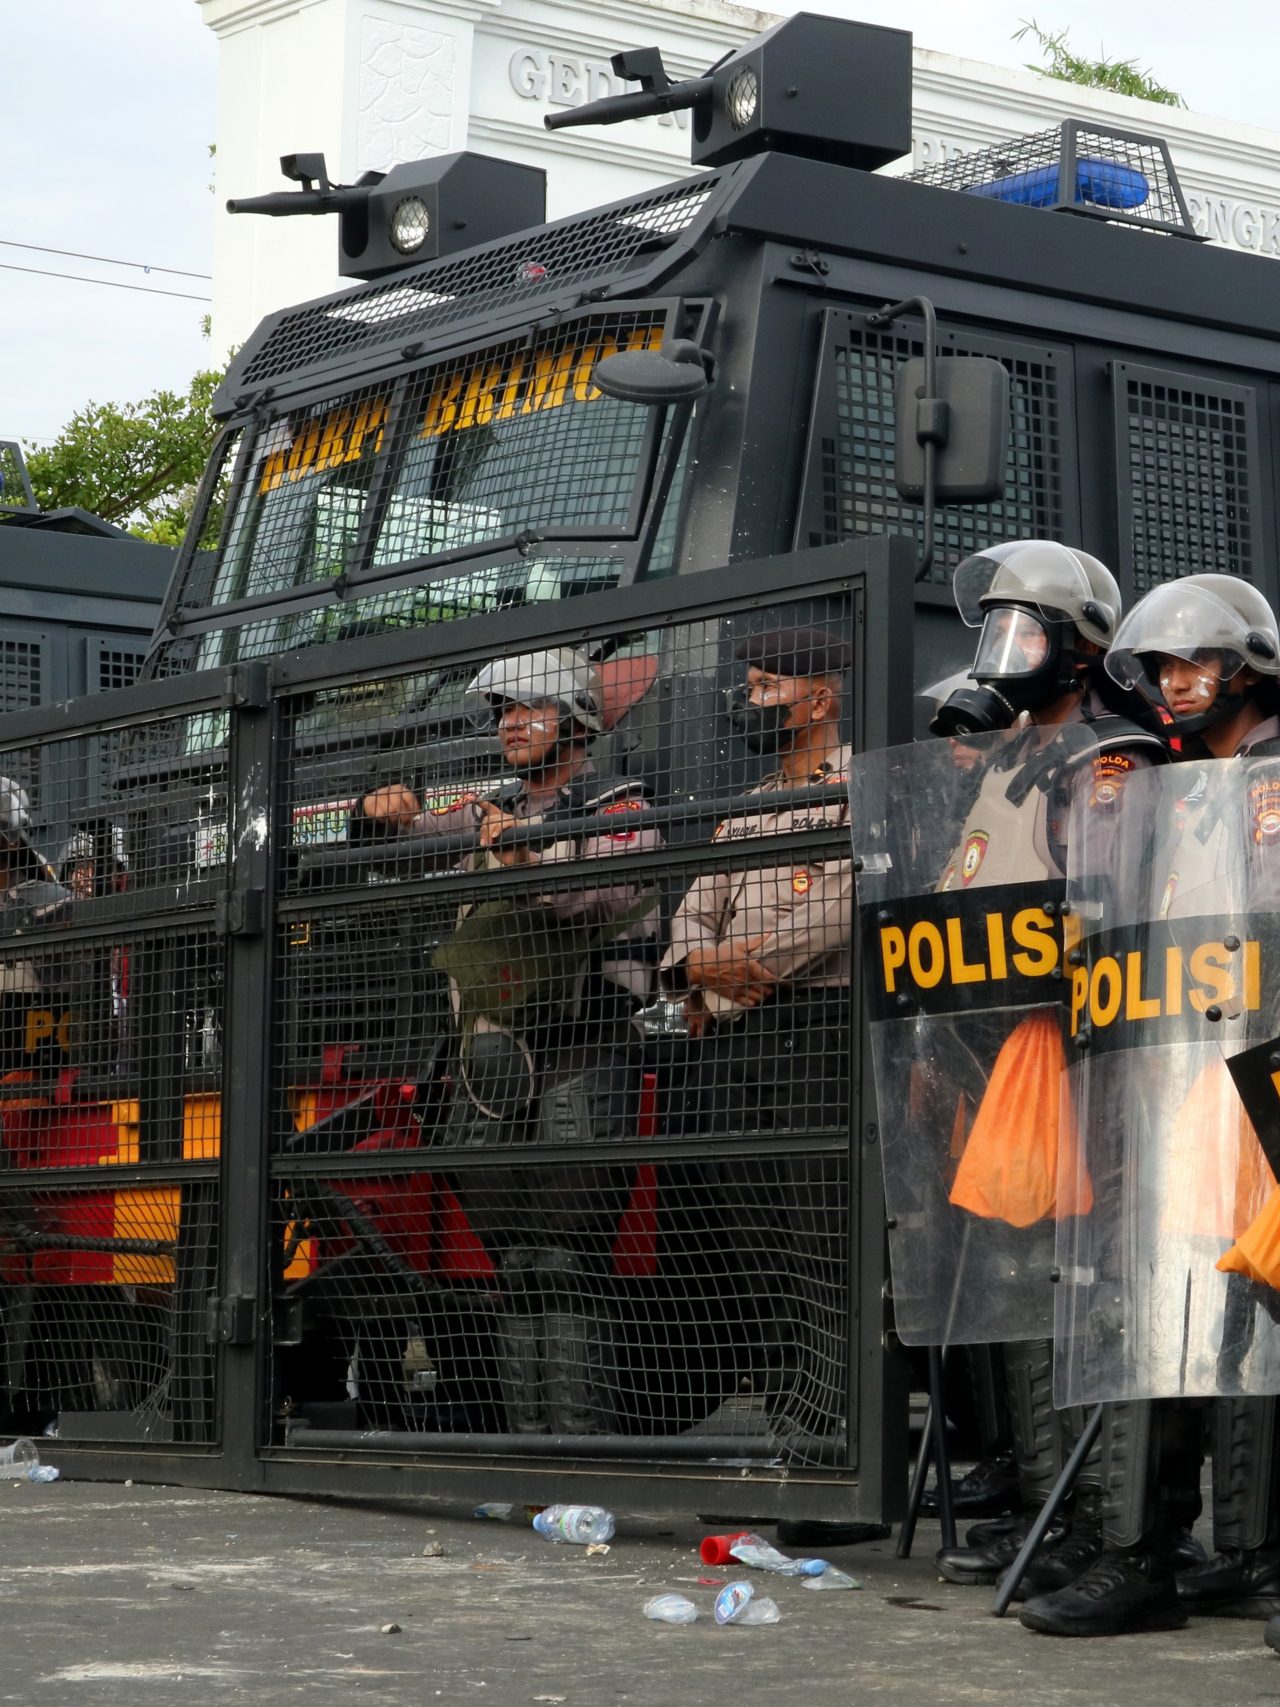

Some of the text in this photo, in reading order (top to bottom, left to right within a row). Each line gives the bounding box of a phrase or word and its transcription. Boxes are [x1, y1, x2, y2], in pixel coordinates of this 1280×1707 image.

[417, 327, 666, 439] BRIMO
[1093, 755, 1129, 769] POLDA
[1071, 941, 1260, 1037] POLISI
